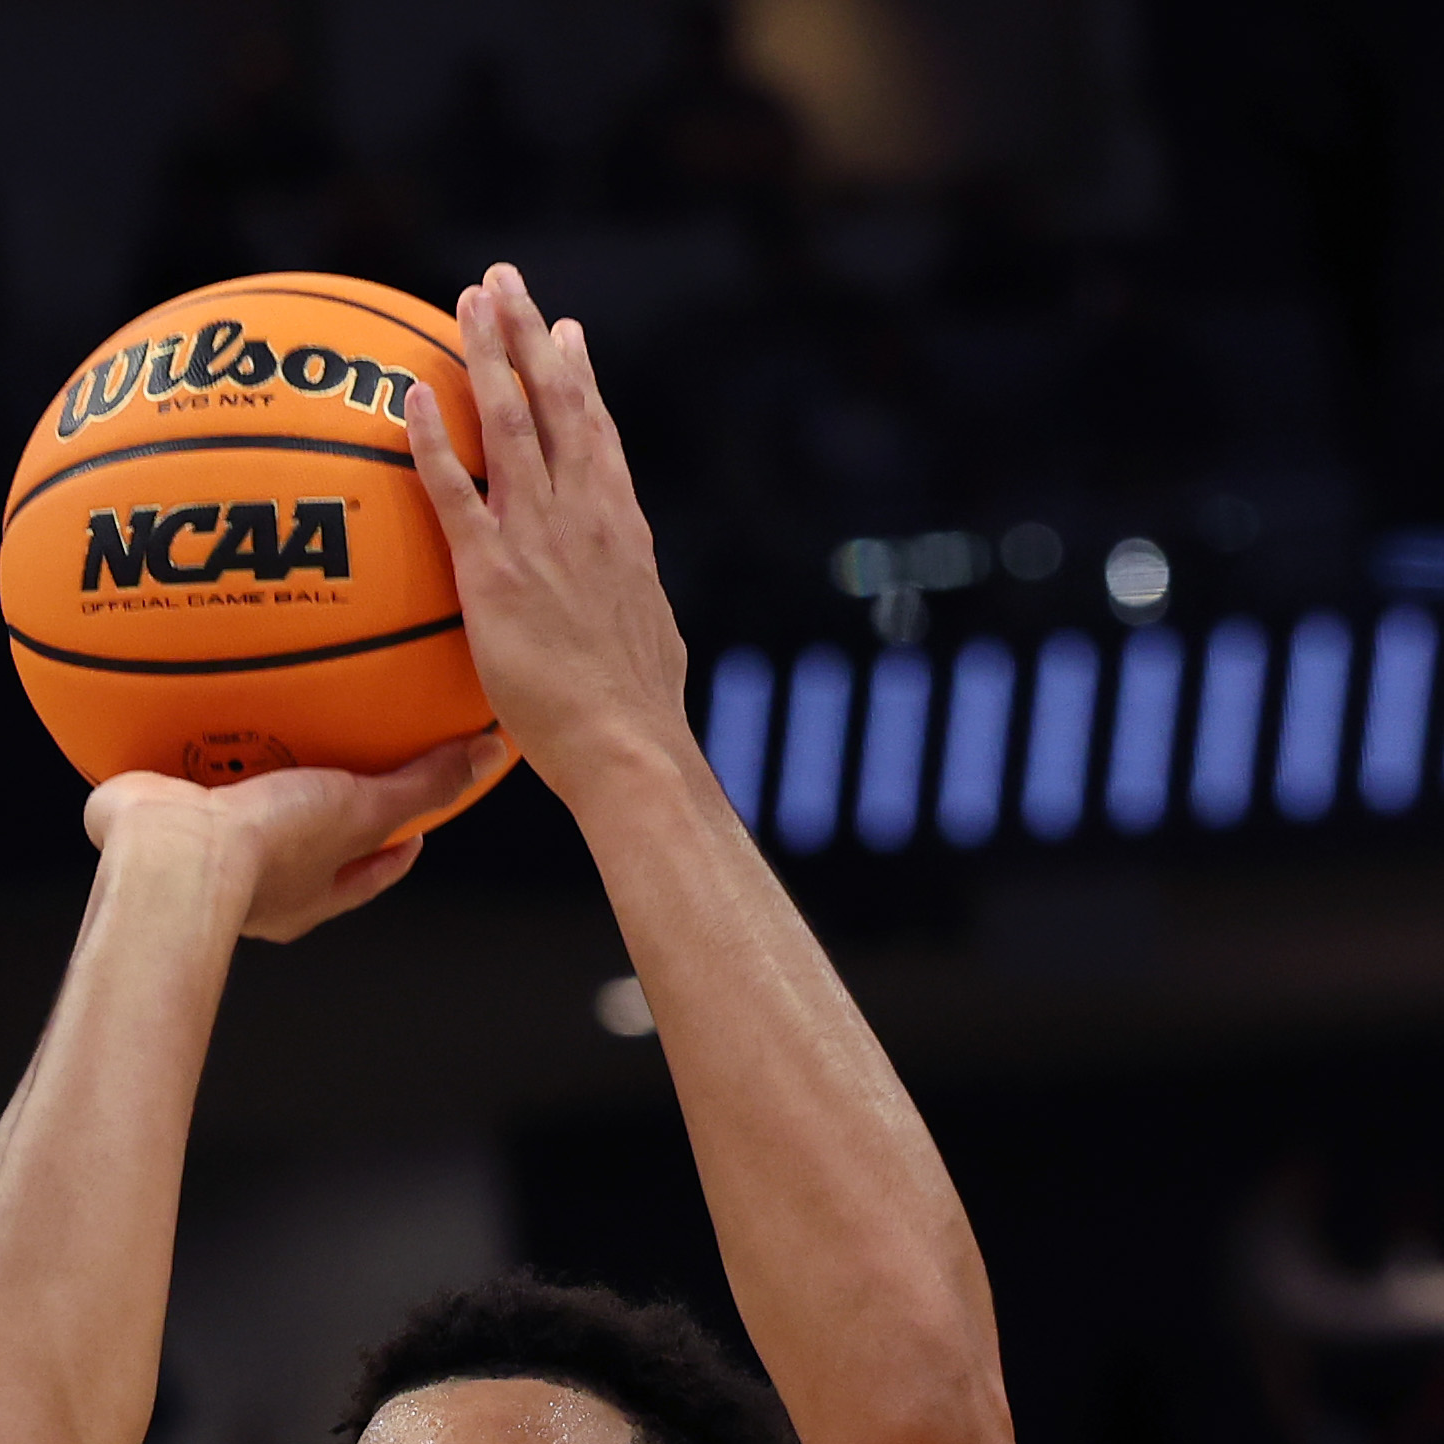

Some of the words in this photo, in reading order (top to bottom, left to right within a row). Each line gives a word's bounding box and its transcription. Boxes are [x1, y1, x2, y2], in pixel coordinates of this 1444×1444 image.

[57, 319, 417, 440] Wilson
[219, 393, 274, 407] NXT
[81, 497, 351, 592] NCAA
[82, 596, 179, 616] OFFICIAL
[186, 590, 266, 607] GAME
[274, 590, 349, 605] BALL
